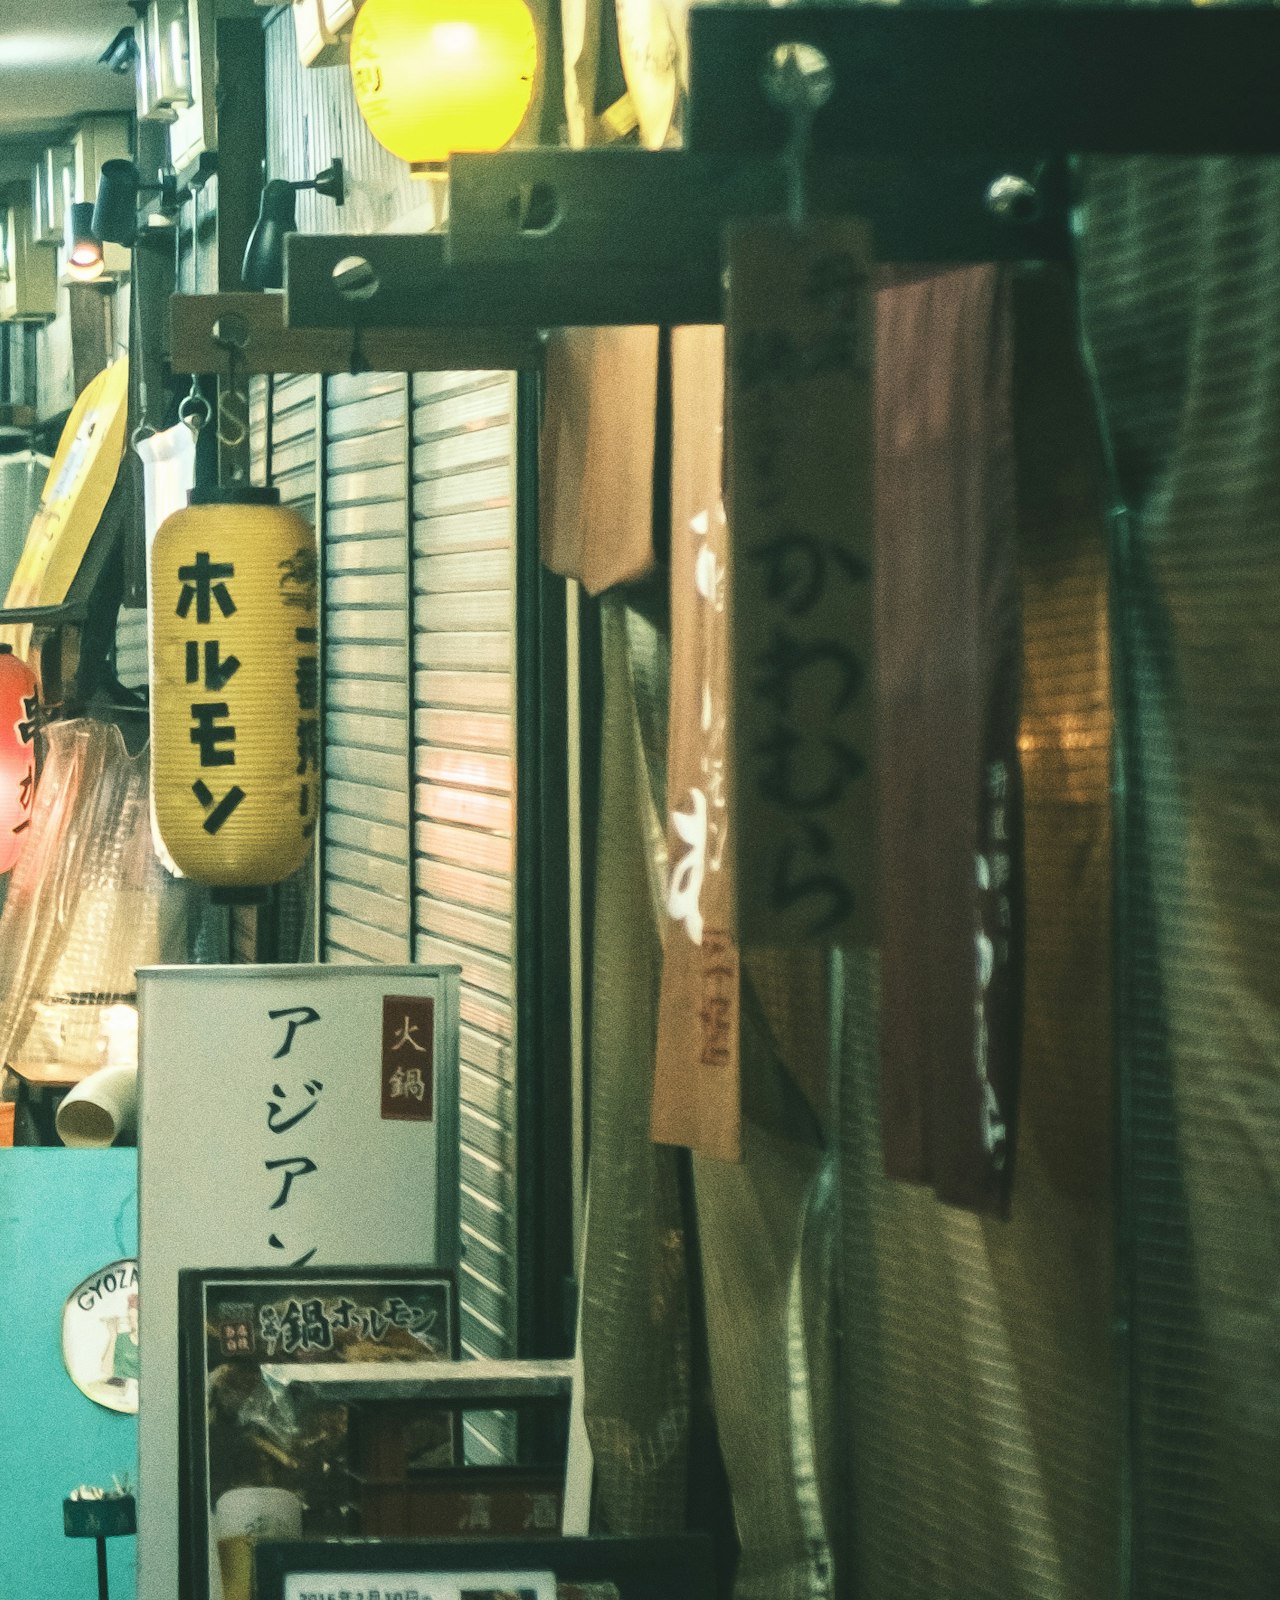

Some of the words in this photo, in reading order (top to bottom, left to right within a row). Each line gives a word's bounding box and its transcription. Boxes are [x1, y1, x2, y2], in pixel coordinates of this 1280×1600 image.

[175, 551, 246, 836] ホルモン
[391, 1015, 427, 1102] 火鍋
